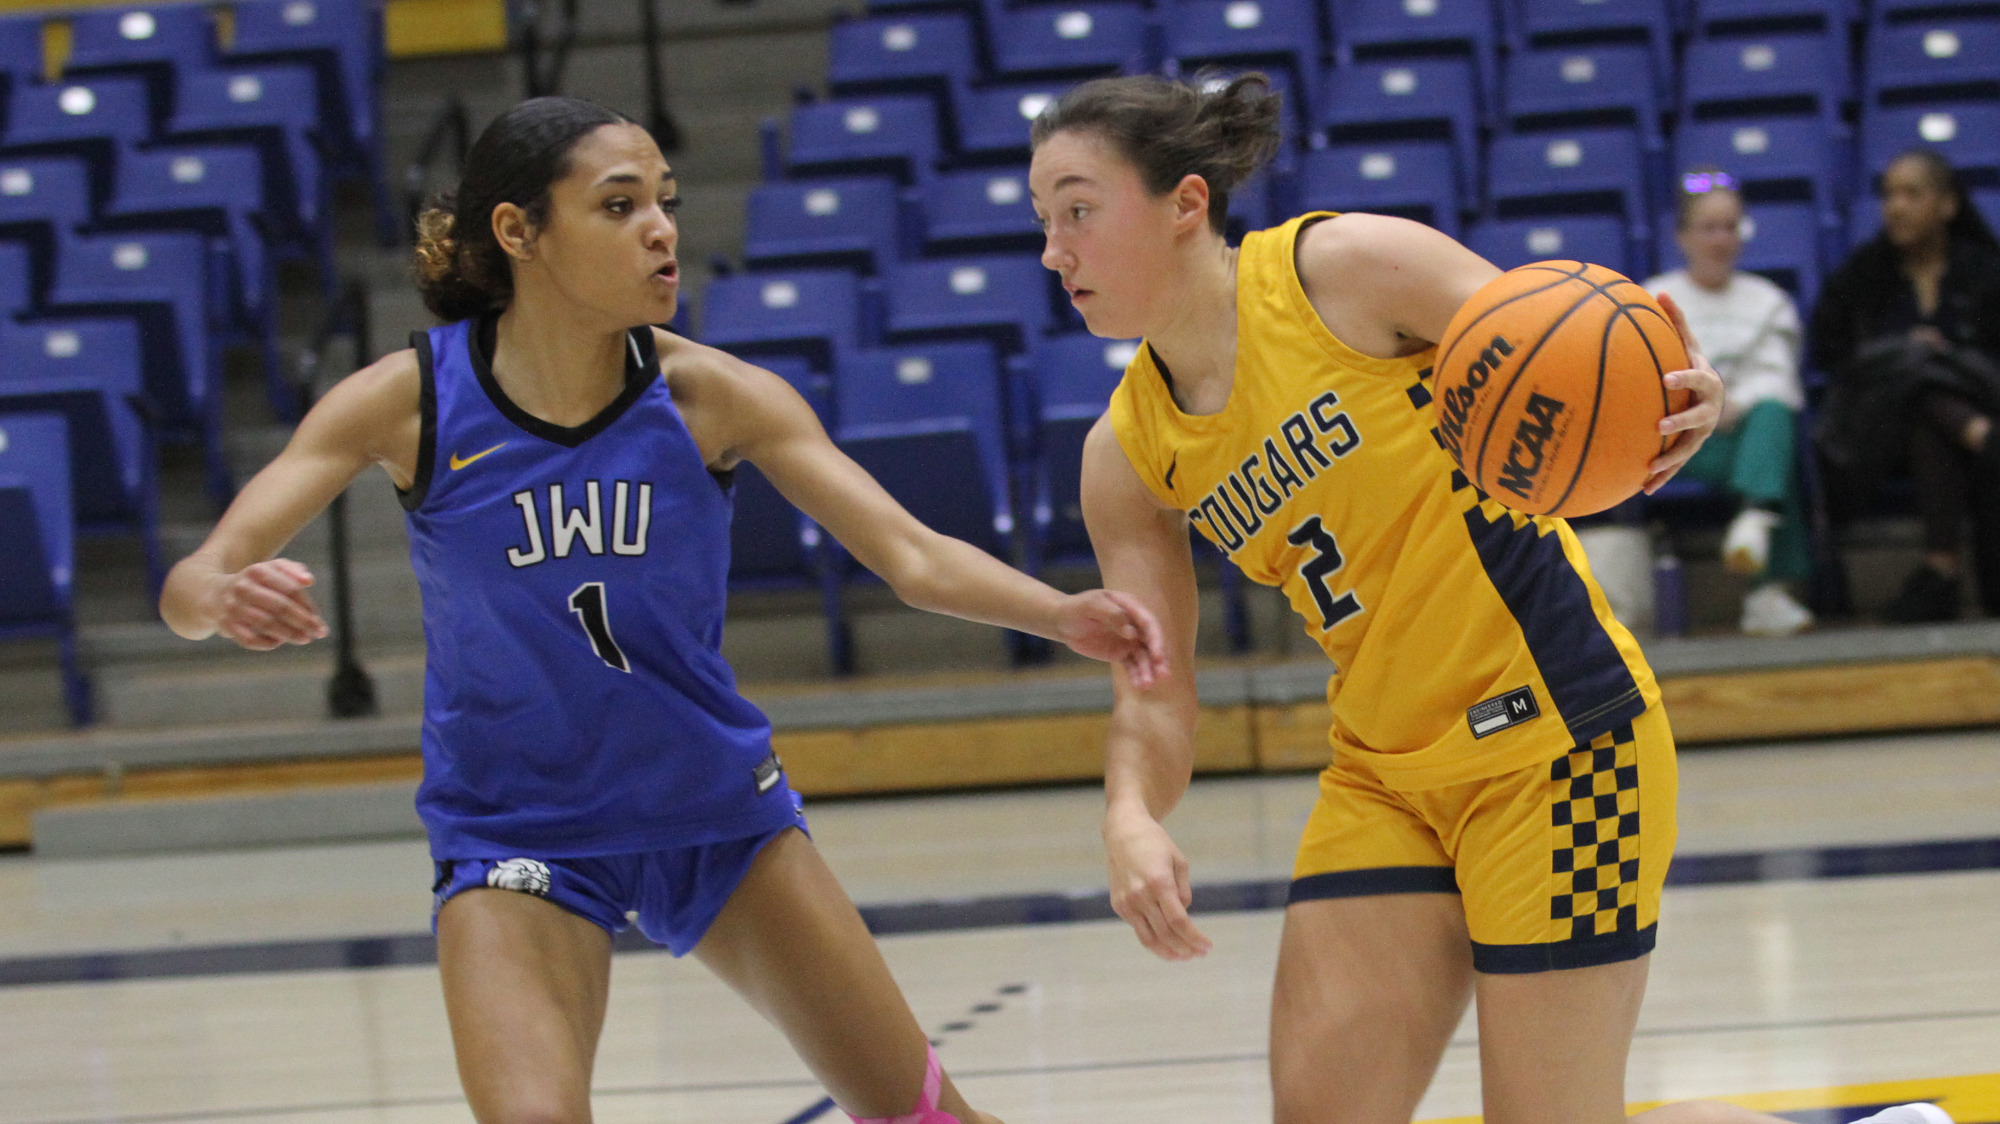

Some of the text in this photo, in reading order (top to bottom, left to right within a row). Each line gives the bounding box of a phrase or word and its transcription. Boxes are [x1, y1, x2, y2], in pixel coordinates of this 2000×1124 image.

[1497, 391, 1565, 499] NCAA
[506, 479, 653, 569] JWU
[1287, 513, 1365, 632] 2
[567, 581, 632, 674] 1
[1511, 697, 1527, 714] M
